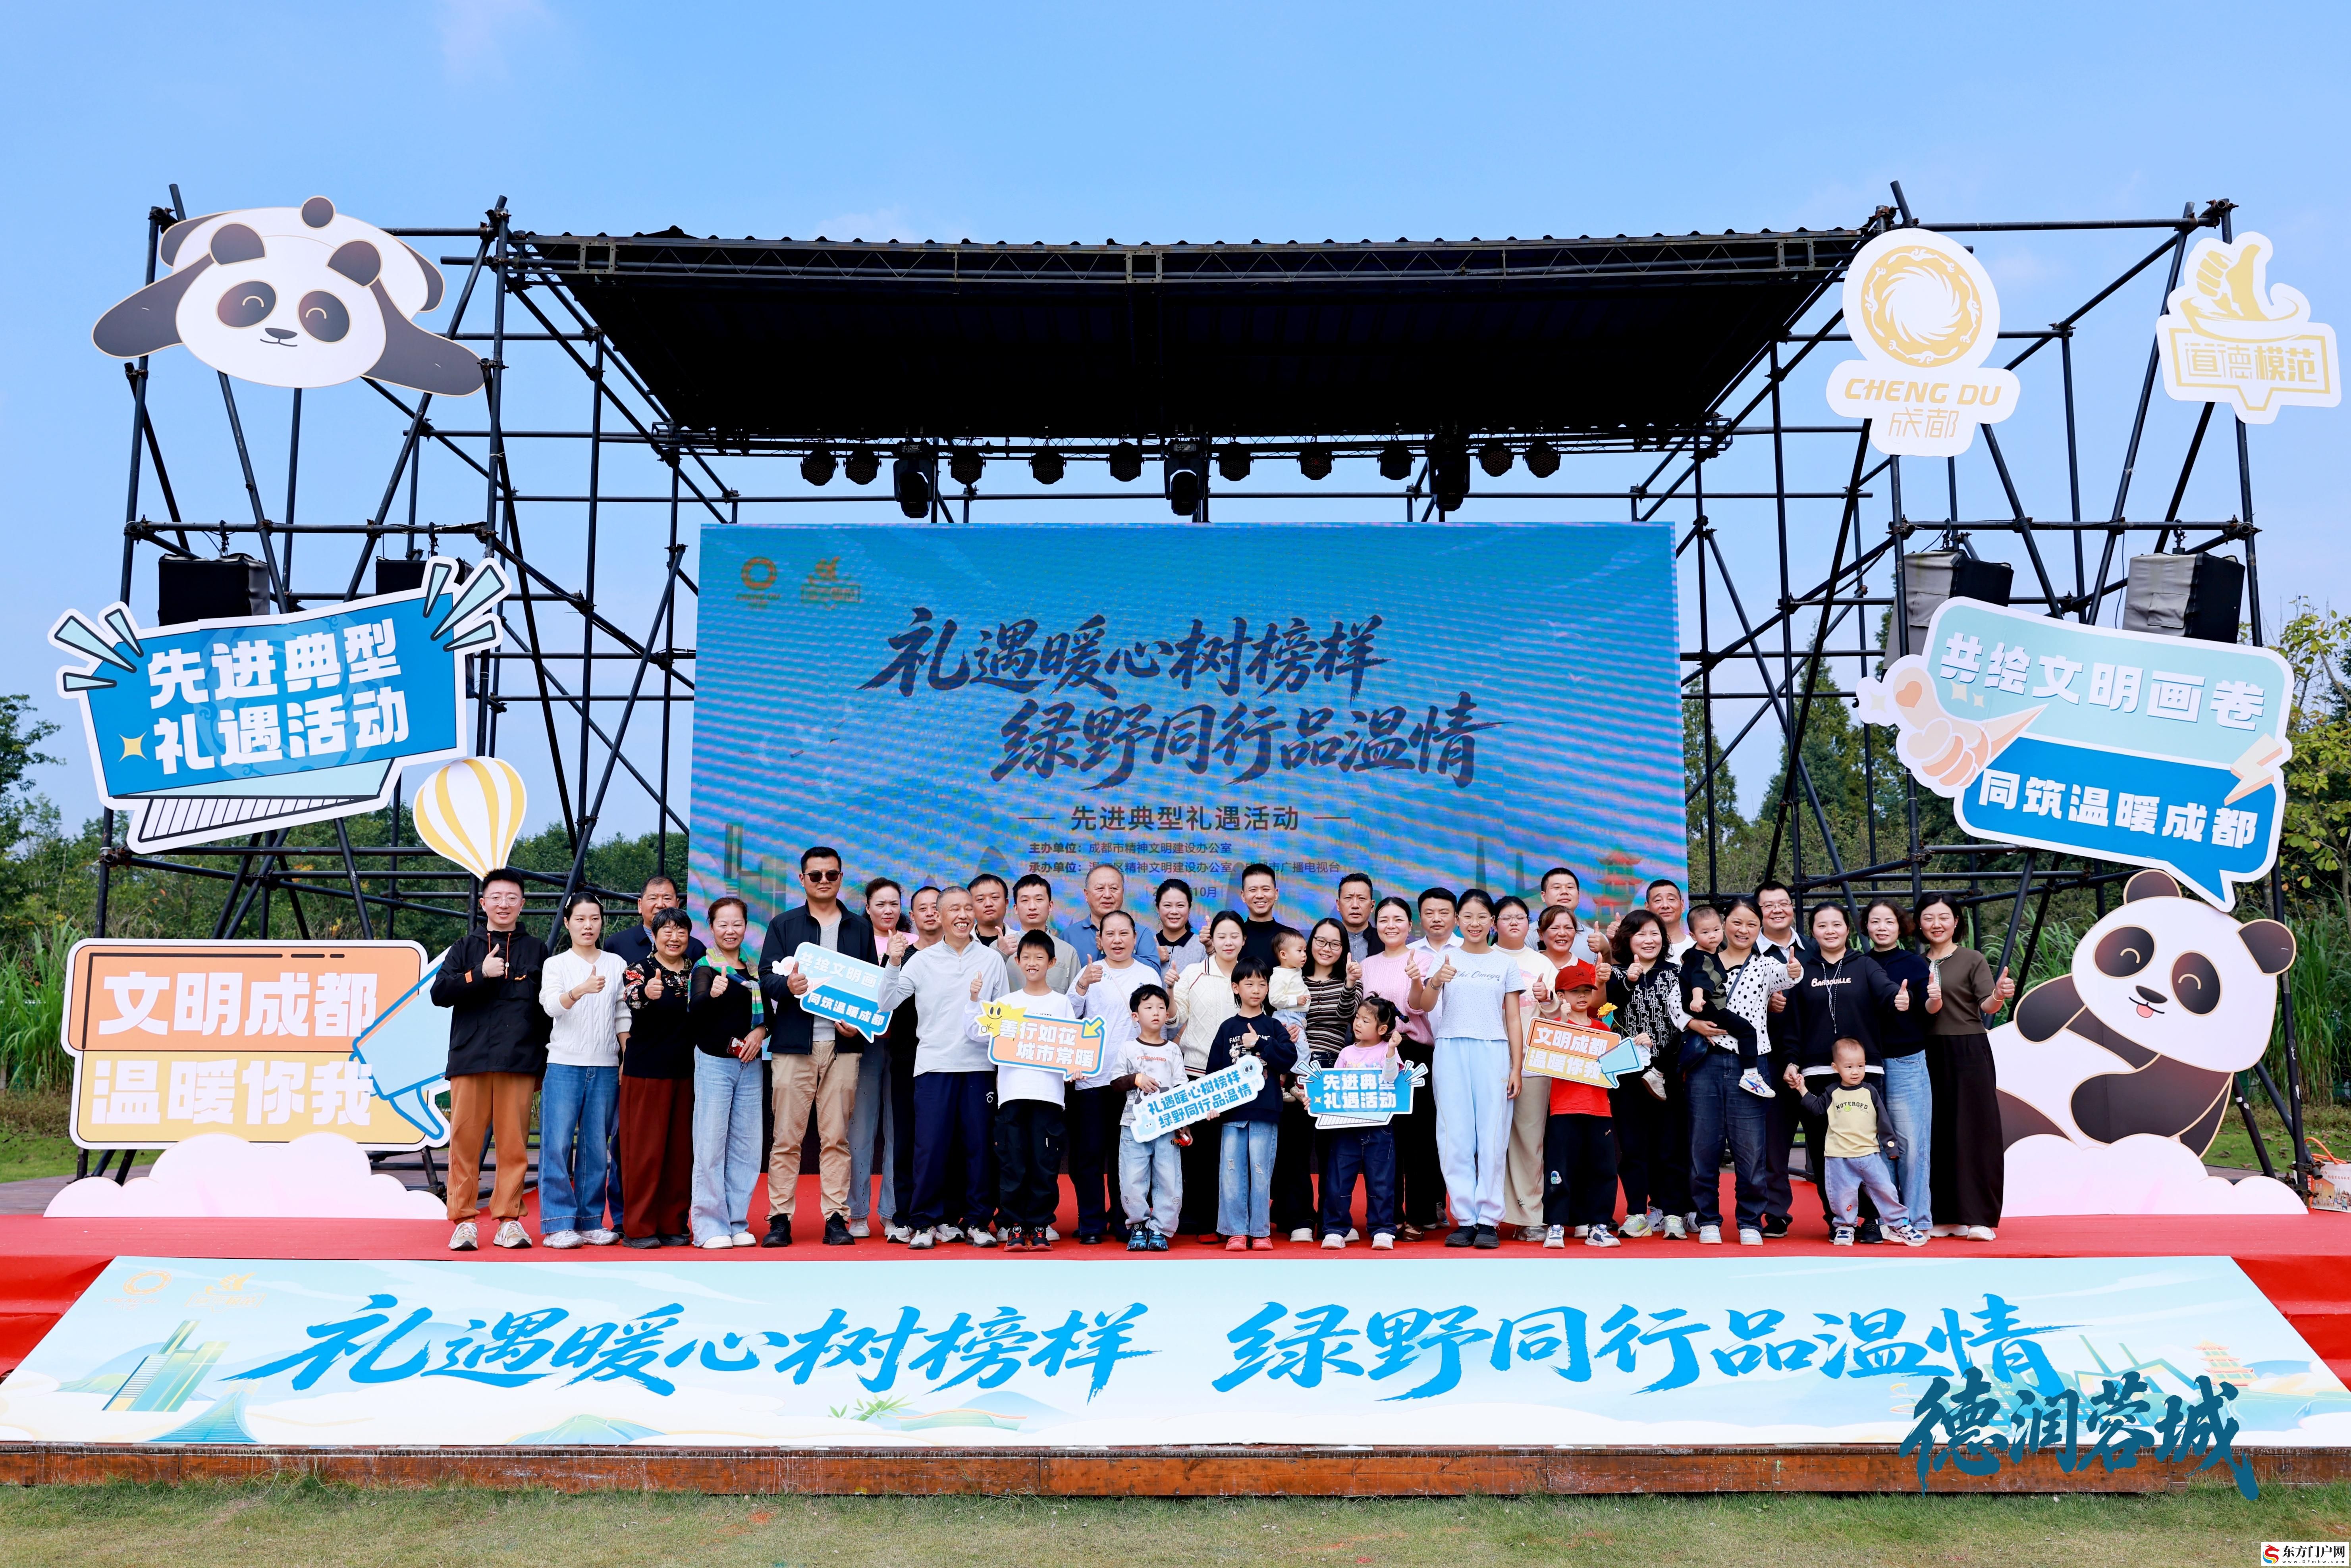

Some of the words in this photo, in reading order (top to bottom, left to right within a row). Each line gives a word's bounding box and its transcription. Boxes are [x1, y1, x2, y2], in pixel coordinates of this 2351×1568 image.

[1844, 378, 1949, 404] CHENG
[1957, 384, 2002, 406] DU
[1888, 407, 1959, 439] 成都
[148, 618, 401, 709] 先进典型
[856, 607, 1391, 707] 礼遇暖心树榜样
[1940, 632, 2265, 731] 共绘文明画卷
[154, 686, 409, 775] 礼遇活动
[990, 691, 1514, 791] 绿野同行品温情
[1071, 806, 1299, 831] 先进典型礼遇活动
[1979, 768, 2259, 849] 同筑温暖成都
[798, 951, 883, 988] 共绘文明画
[1471, 971, 1500, 980] Omega
[98, 971, 377, 1037] 文明成都
[807, 992, 885, 1026] 同筑温暖成都
[999, 1019, 1077, 1046] 善行如花
[1533, 1027, 1608, 1057] 文明成都
[1016, 1041, 1095, 1068] 城市常暖
[1528, 1050, 1602, 1080] 温暖你我
[91, 1059, 373, 1126] 温暖你我
[1147, 1070, 1241, 1115] 礼遇暖心树榜样
[1158, 1083, 1252, 1129] 绿野同行品温情
[1324, 1092, 1396, 1109] 礼遇活动
[216, 1293, 1163, 1405] 礼遇暖心树榜样
[1212, 1293, 2095, 1403] 绿野同行品温情
